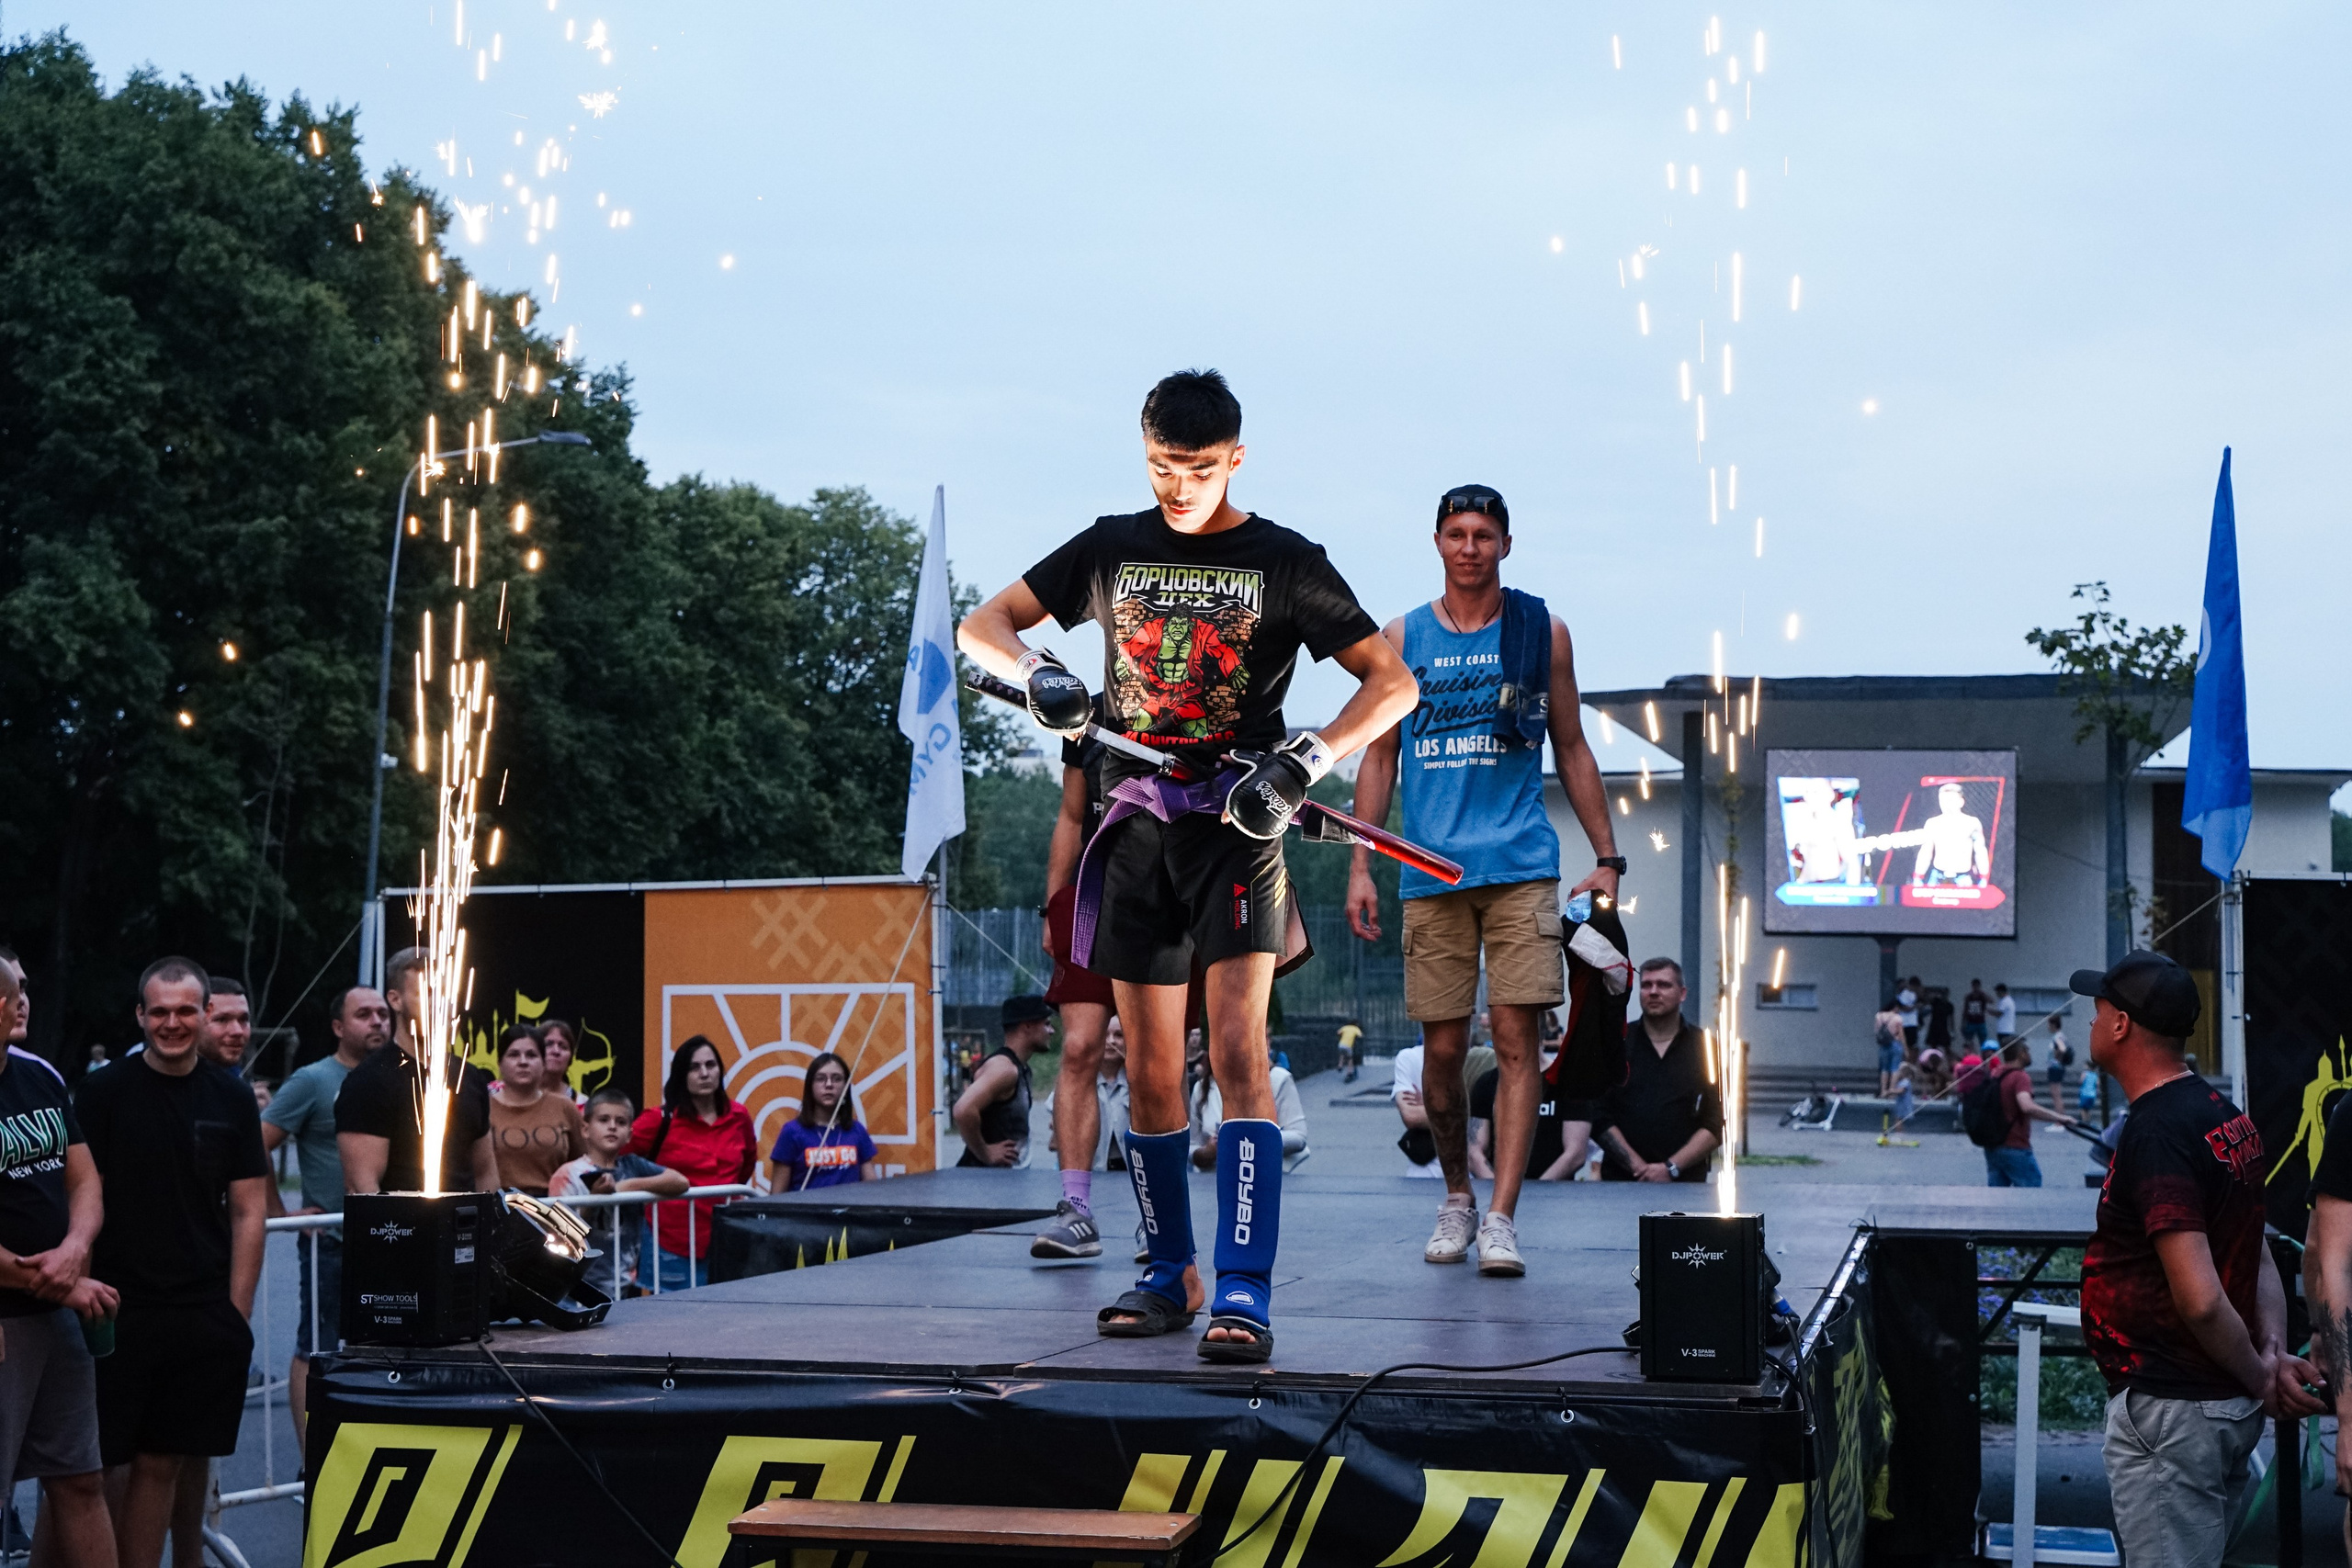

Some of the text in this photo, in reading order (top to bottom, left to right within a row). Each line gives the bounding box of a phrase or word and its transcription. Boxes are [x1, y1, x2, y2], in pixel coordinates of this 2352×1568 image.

[1153, 592, 1216, 607] ЦЕХ
[1434, 654, 1498, 667] WEST COAST
[1411, 694, 1499, 738] Divisio
[1416, 739, 1440, 758] LOS
[1424, 761, 1445, 770] SIMPLY
[1480, 758, 1497, 766] SIGNS
[1255, 781, 1292, 818] Fairtex
[7, 1157, 64, 1179] NEW YORK
[1129, 1146, 1159, 1235] BOYBO
[1234, 1136, 1255, 1245] BOYBO
[370, 1227, 413, 1236] DJPOWER
[1671, 1250, 1724, 1260] DJPOWER
[360, 1294, 373, 1304] ST
[395, 1294, 417, 1303] TOOLS
[374, 1315, 387, 1324] V-3
[1681, 1348, 1698, 1357] V-3
